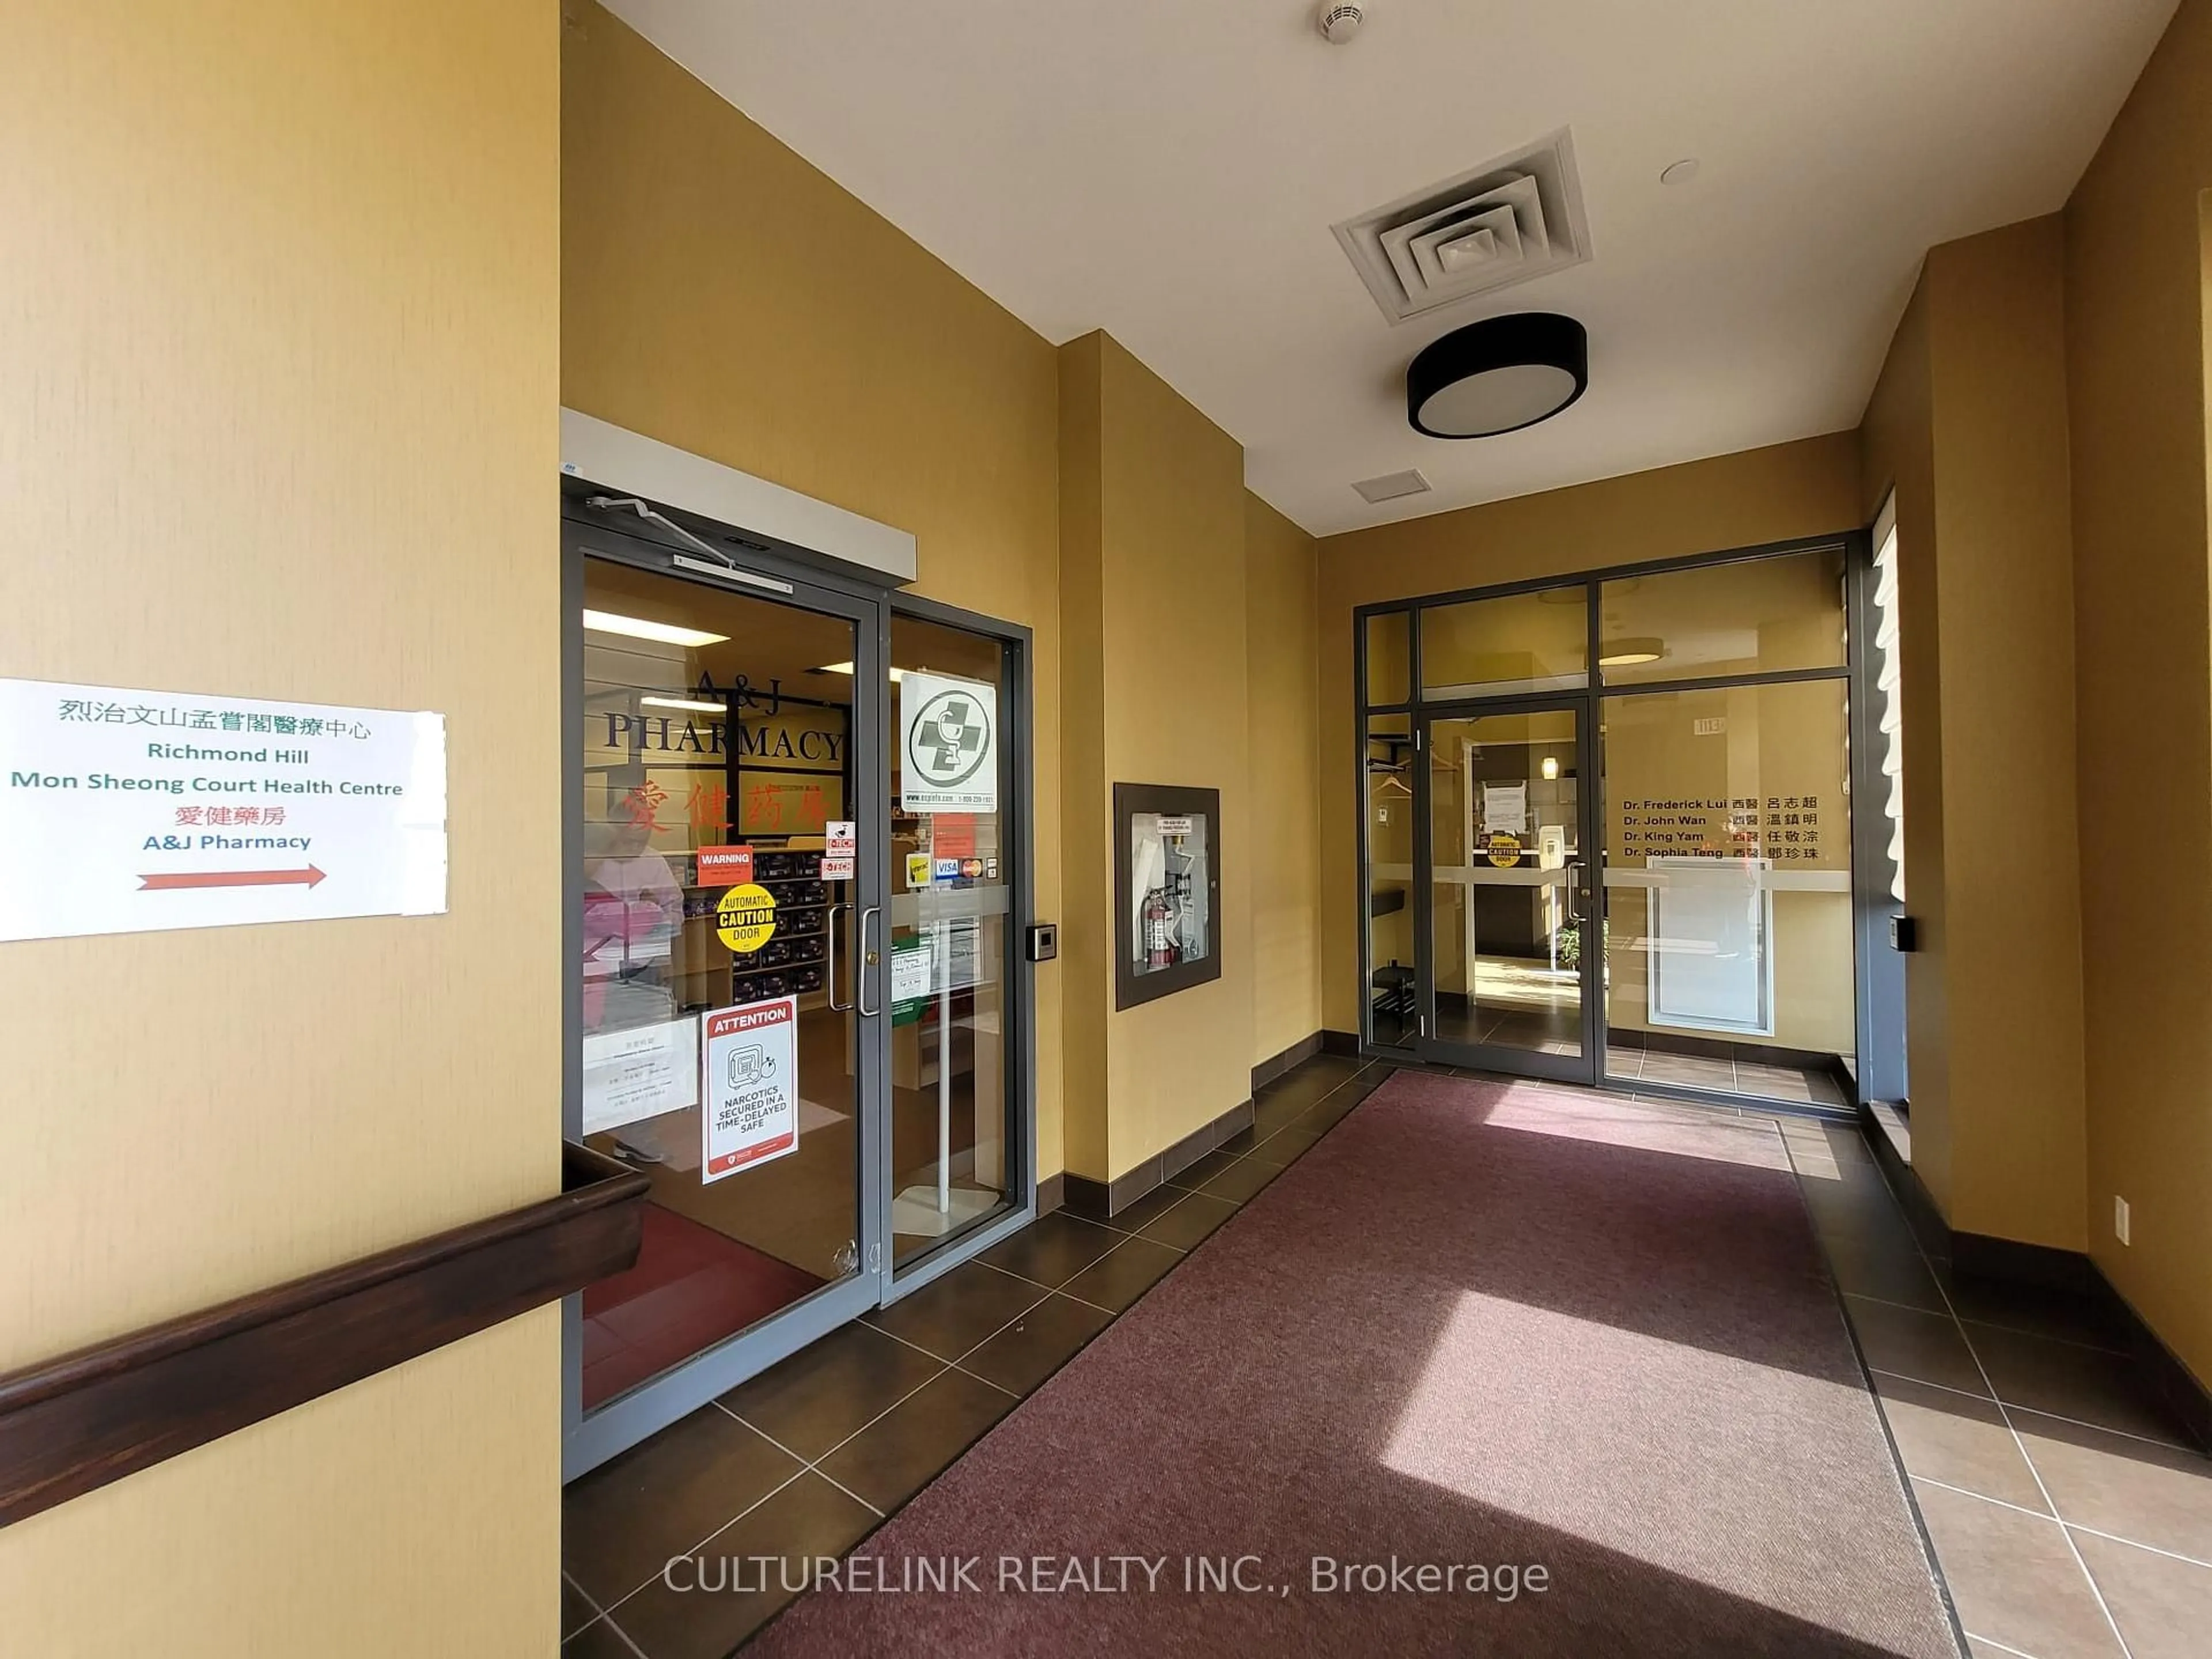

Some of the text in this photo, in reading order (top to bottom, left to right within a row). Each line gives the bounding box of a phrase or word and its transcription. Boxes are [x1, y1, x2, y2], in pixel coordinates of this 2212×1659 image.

[695, 670, 782, 717] A & J
[604, 712, 843, 761] PHARMACY
[149, 743, 309, 764] Richmond Hill
[11, 772, 403, 796] Mon Sheong Court Health Centre
[1623, 801, 1640, 809] Dr.
[1644, 800, 1703, 809] Frederick
[1707, 799, 1727, 809] Lui
[175, 806, 287, 826] 愛健藥房
[1624, 816, 1640, 825] Dr.
[1644, 816, 1675, 825] John
[1678, 816, 1706, 825] Wan
[143, 835, 312, 851] A&J Pharmacy
[1624, 832, 1641, 840] Dr.
[1645, 832, 1672, 843] King
[1676, 832, 1704, 841] Yam
[702, 854, 749, 865] WARNING
[1624, 847, 1641, 857] Dr.
[1645, 847, 1687, 858] Sophia
[1692, 847, 1723, 859] Teng
[938, 862, 957, 873] VISA
[725, 895, 768, 909] AUTOMATIC
[720, 908, 774, 927] CAUTION
[733, 927, 760, 940] DOOR
[715, 1007, 786, 1033] ATTENTION
[725, 1085, 778, 1108] NARCOTICS
[719, 1094, 784, 1120] SECURED IN A
[717, 1103, 786, 1131] TIME-DELAYED
[741, 1118, 764, 1133] SAFE
